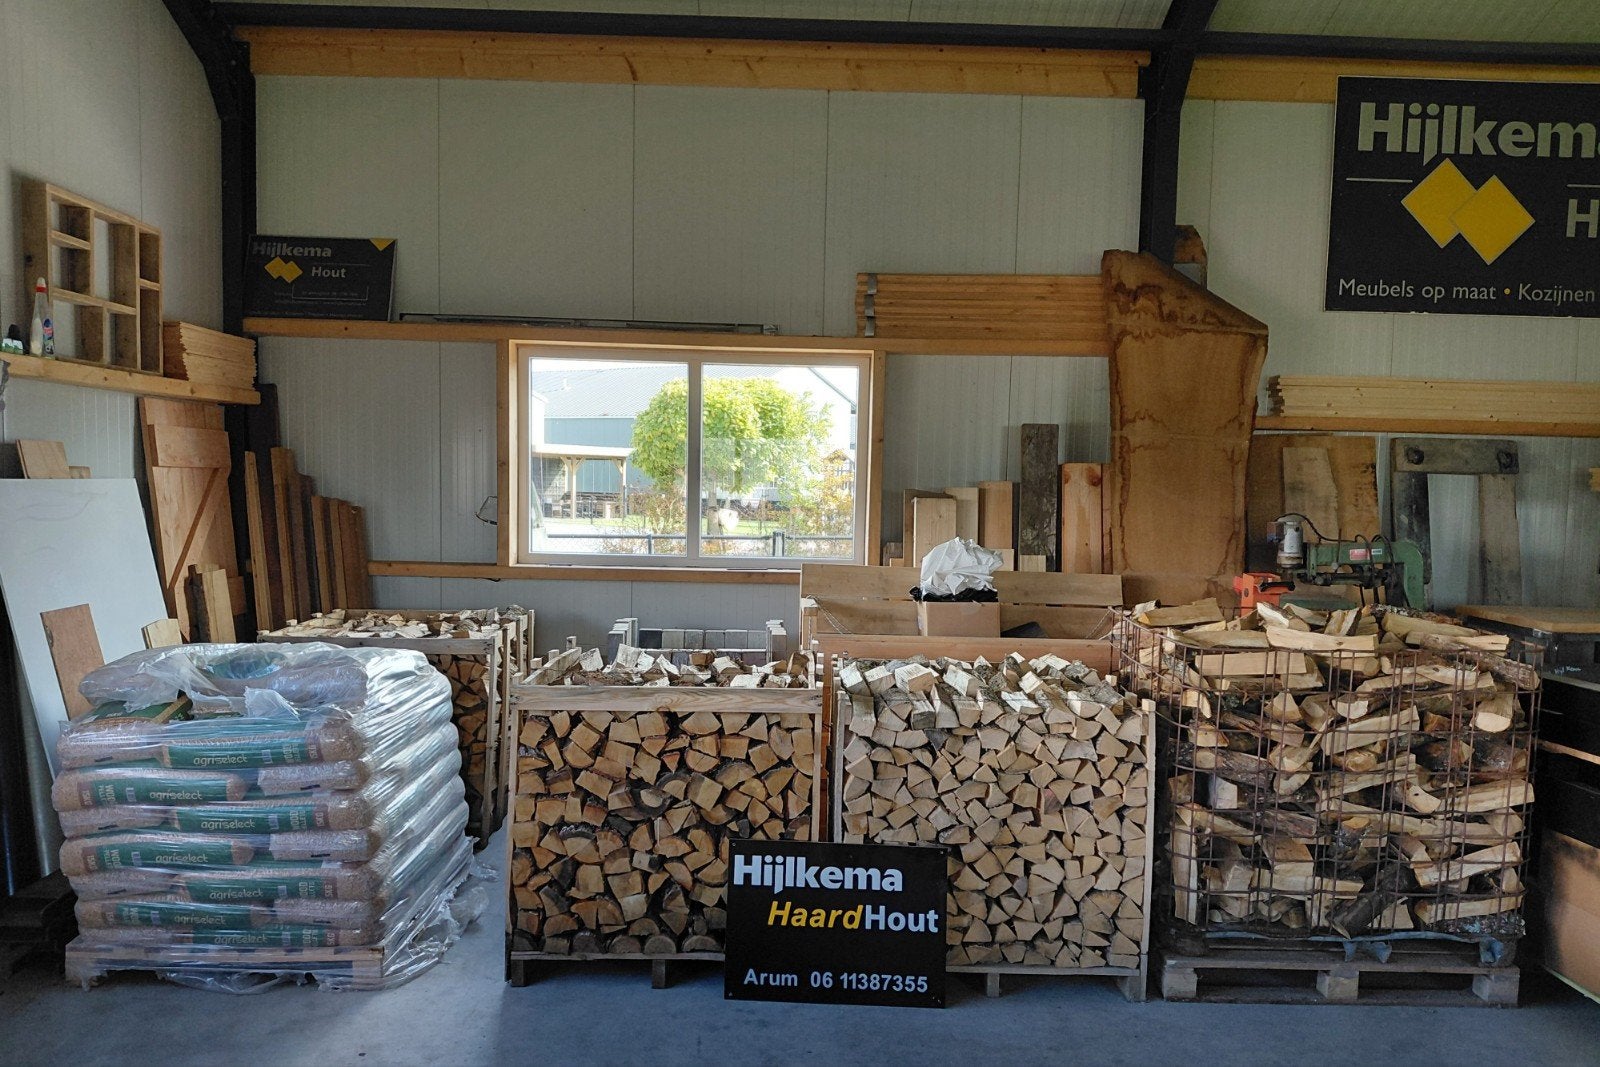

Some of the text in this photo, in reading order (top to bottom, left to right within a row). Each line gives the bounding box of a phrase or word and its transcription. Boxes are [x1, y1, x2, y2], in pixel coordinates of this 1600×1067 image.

[1358, 102, 1600, 166] Hijlkem
[252, 242, 332, 257] Hijlkema
[311, 266, 347, 279] Hout
[1338, 278, 1595, 306] Meubels op maat Kozijnen
[193, 754, 248, 767] agriselect
[149, 788, 203, 799] agriselect
[201, 819, 256, 830] agriselect
[155, 853, 209, 863] agriselect
[733, 854, 903, 894] Hijlkema
[208, 887, 264, 900] agriselect
[174, 913, 226, 924] agriselect
[767, 901, 939, 933] HaardHout
[214, 934, 268, 944] agriselect
[743, 968, 929, 993] Arum 06 11387355
